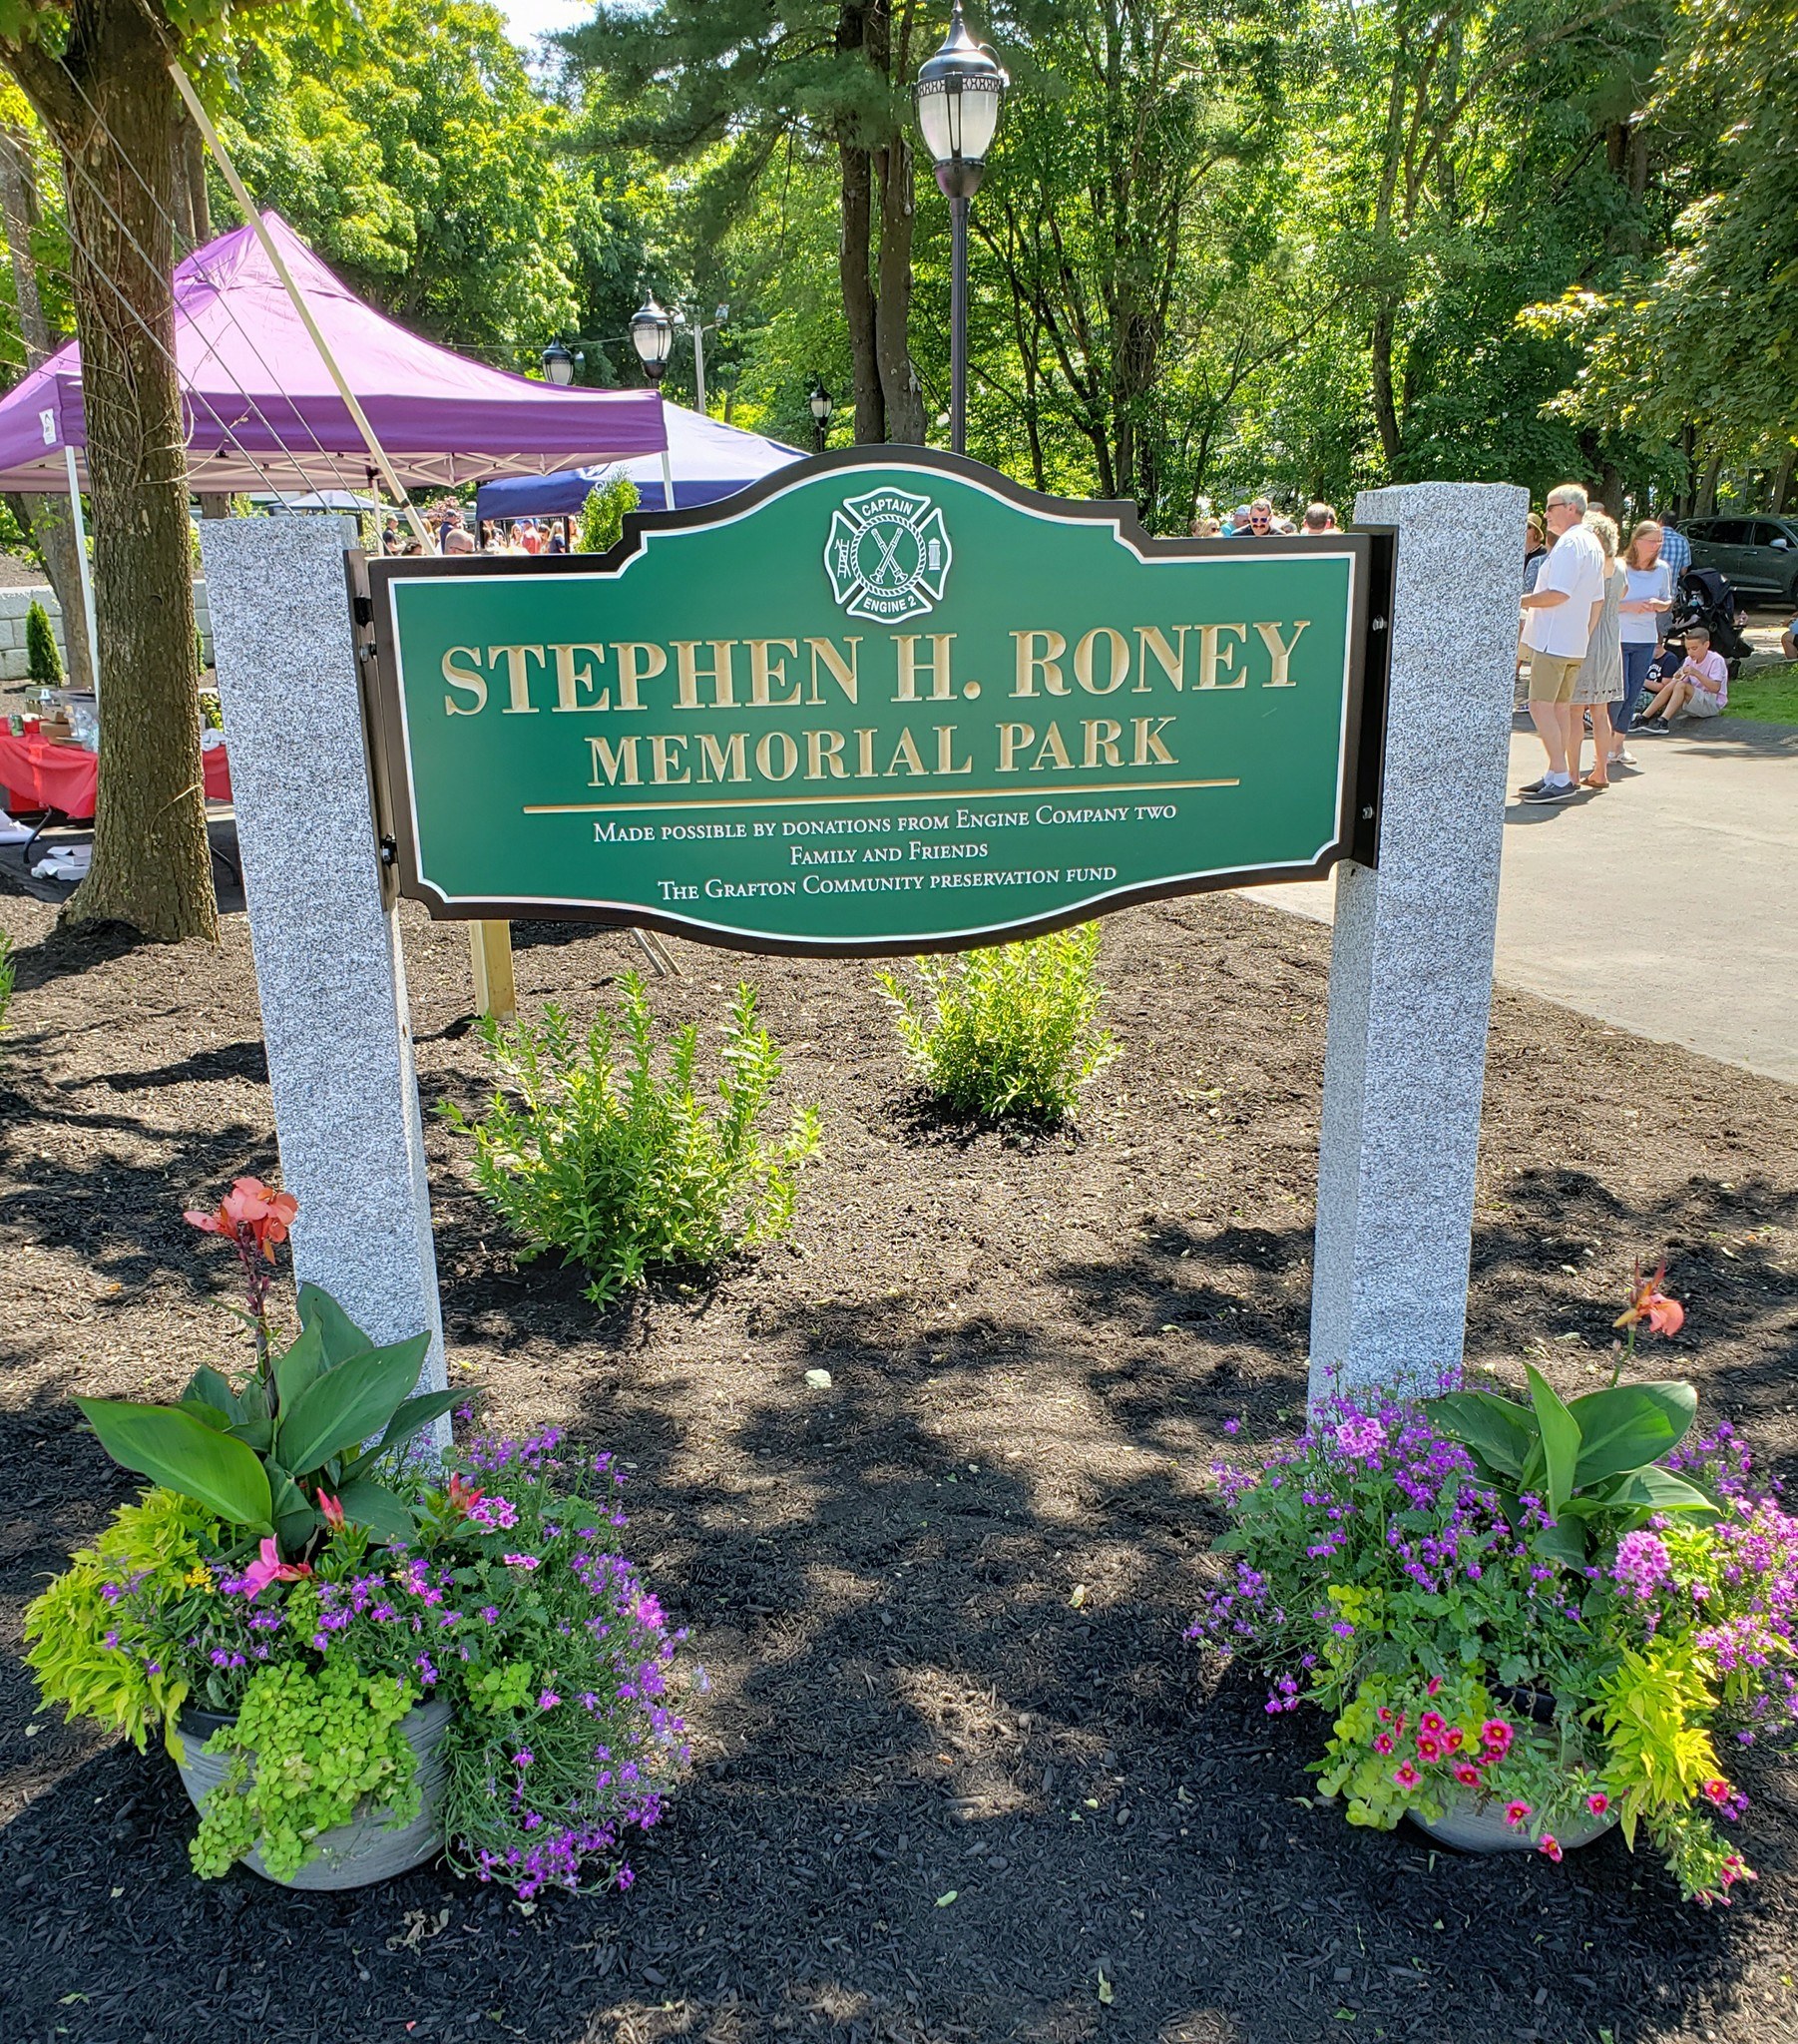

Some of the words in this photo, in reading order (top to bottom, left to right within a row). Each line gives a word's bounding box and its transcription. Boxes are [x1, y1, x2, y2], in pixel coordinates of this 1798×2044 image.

[861, 498, 913, 516] CAPTAIN
[863, 597, 907, 613] ENGINE
[908, 595, 917, 607] 2
[442, 637, 864, 716] STEPHEN
[890, 634, 982, 703] H.
[1009, 621, 1311, 697] RONEY
[585, 727, 974, 787] MEMORIAL
[995, 716, 1179, 771] PARK
[593, 822, 656, 842] MADE
[661, 823, 747, 840] POSSIBLE
[753, 822, 776, 837] BY
[782, 818, 891, 835] DONATIONS
[897, 814, 950, 831] FROM
[956, 808, 1030, 829] ENGINE
[1036, 804, 1128, 825] COMPANY
[1134, 804, 1177, 819] TWO
[789, 845, 857, 865] FAMILY
[862, 846, 902, 863] AND
[908, 840, 989, 861] FRIENDS
[658, 880, 699, 900] THE
[704, 878, 796, 899] GRAFTON
[802, 874, 924, 895] COMMUNITY
[930, 869, 1060, 889] PRESERVATION
[1065, 866, 1118, 882] FUND
